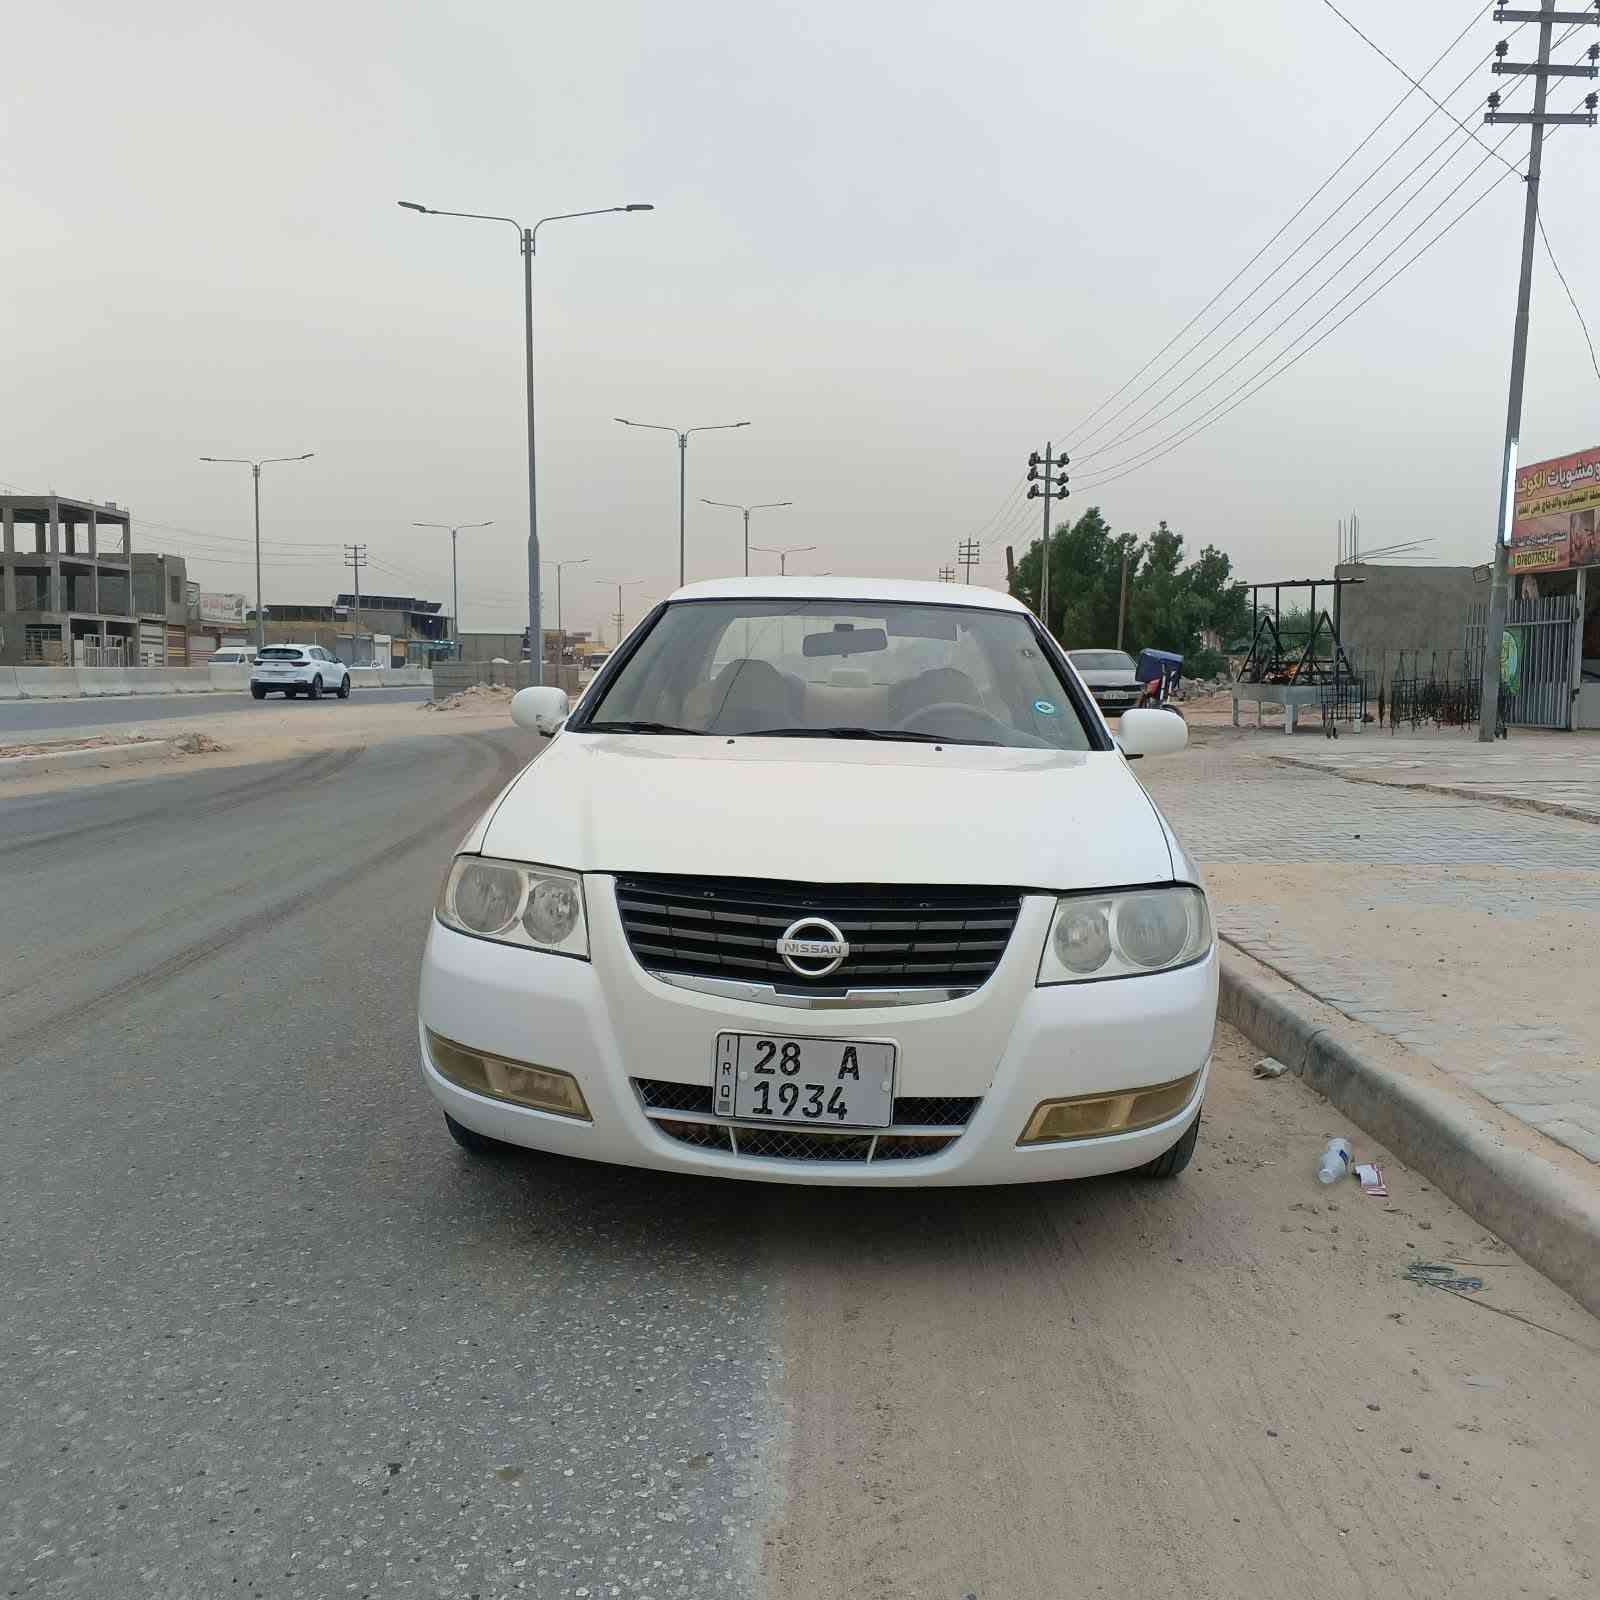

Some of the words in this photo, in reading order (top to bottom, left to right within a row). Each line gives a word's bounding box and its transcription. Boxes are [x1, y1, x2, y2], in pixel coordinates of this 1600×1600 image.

[784, 942, 842, 954] NISSAN
[754, 1040, 801, 1076] 28
[838, 1046, 860, 1080] A
[753, 1081, 848, 1121] 1934
